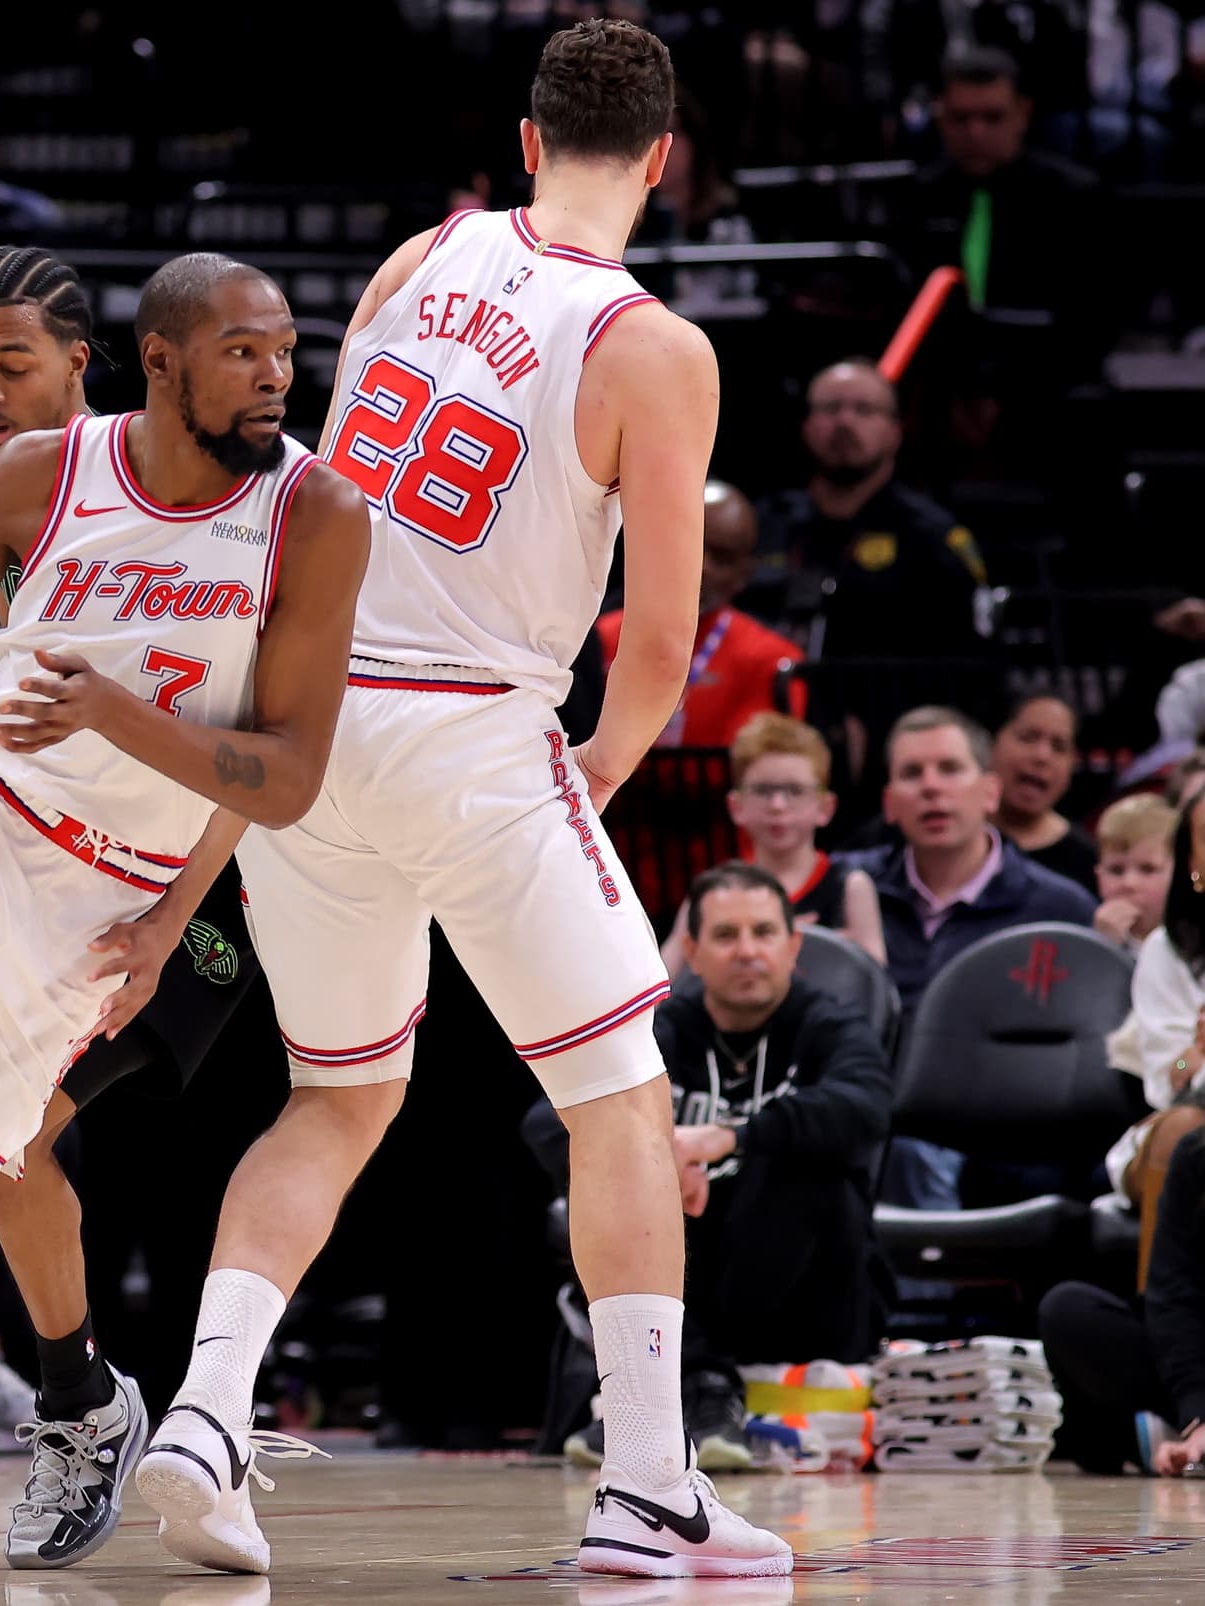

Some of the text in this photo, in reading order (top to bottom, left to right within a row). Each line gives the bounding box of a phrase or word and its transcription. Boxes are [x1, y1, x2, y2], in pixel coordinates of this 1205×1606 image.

[417, 292, 540, 391] SENGUN
[324, 350, 530, 555] 28
[210, 520, 268, 540] MEMORIAL
[38, 558, 258, 622] H-Town
[140, 645, 212, 718] 7
